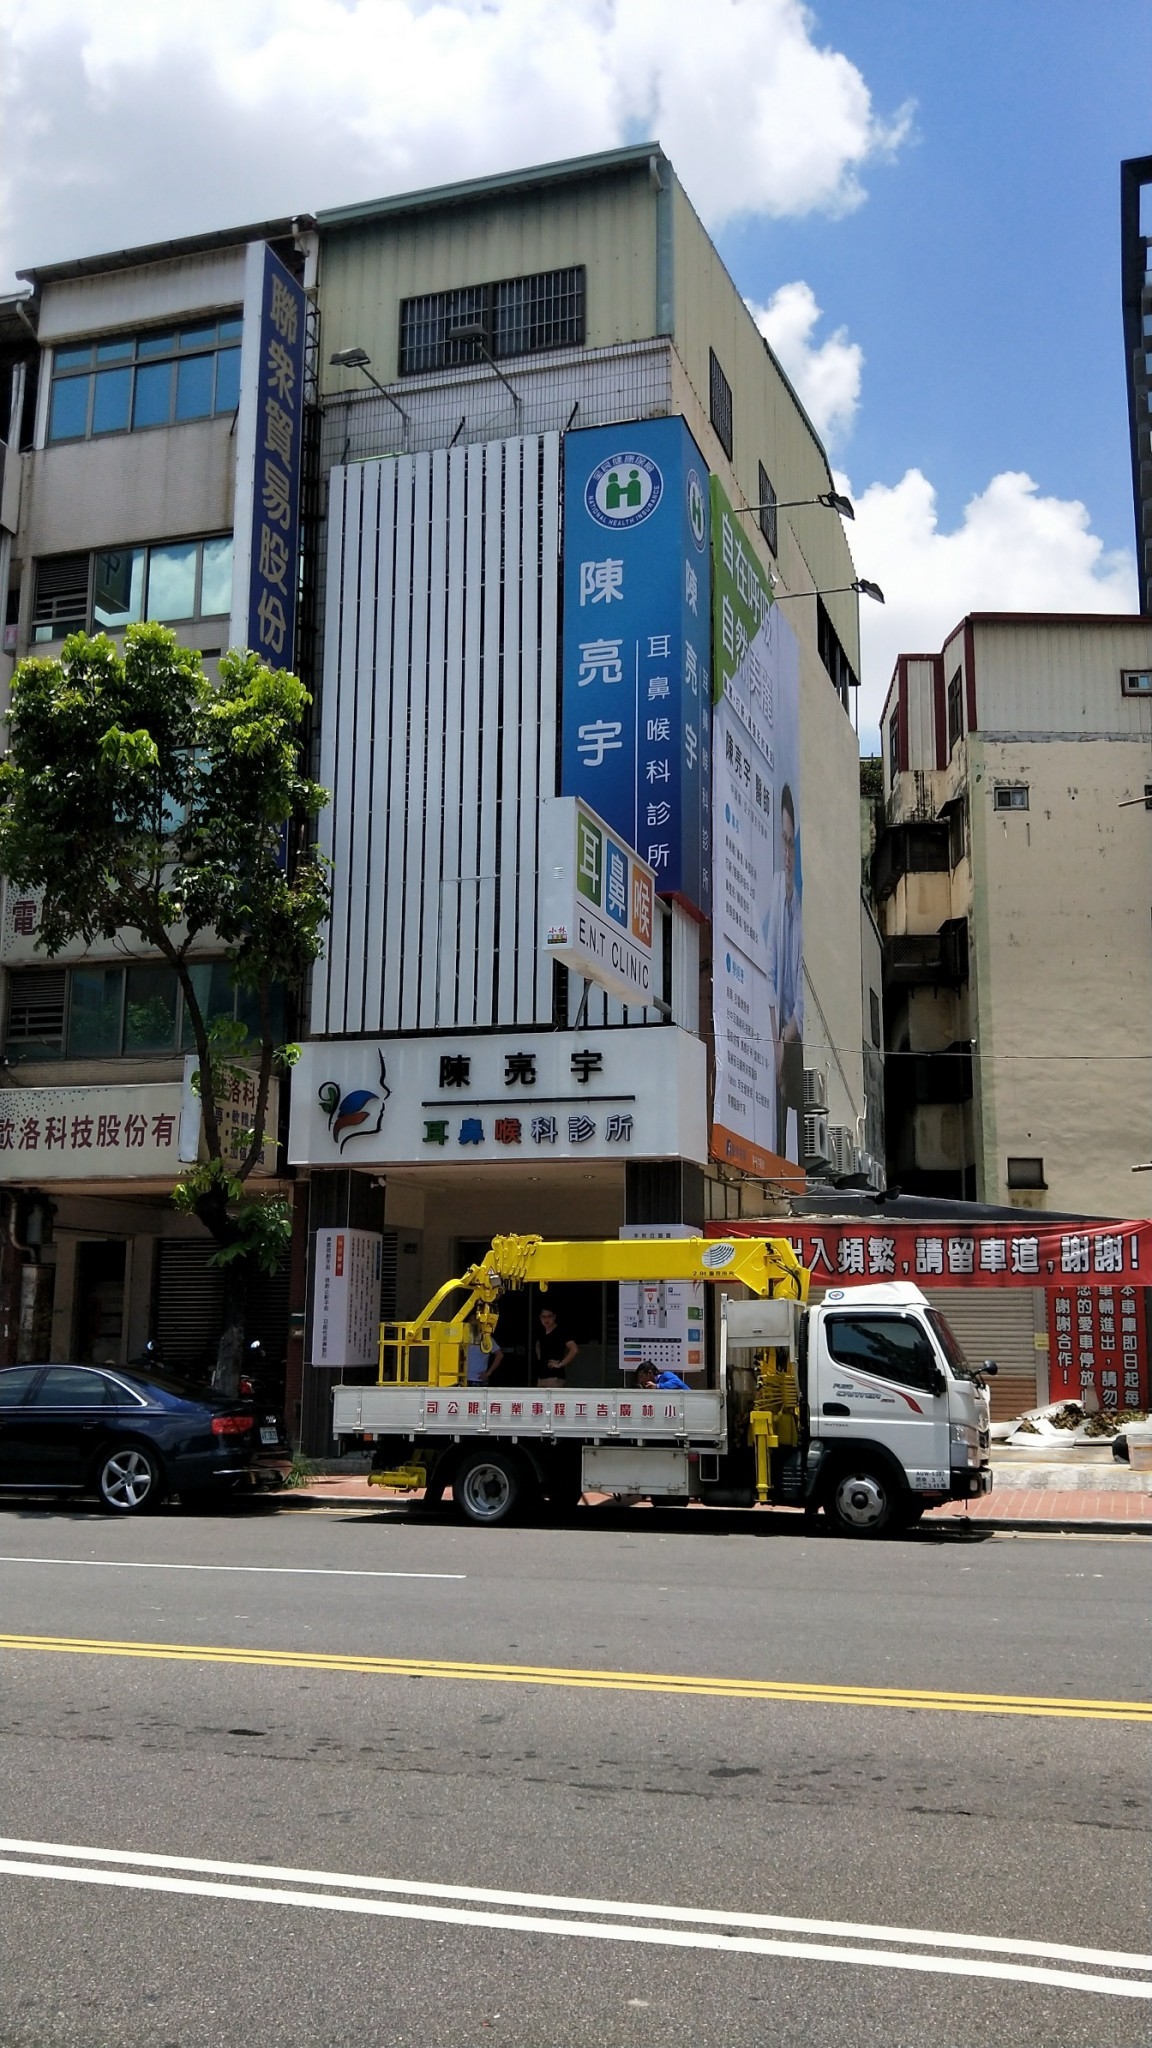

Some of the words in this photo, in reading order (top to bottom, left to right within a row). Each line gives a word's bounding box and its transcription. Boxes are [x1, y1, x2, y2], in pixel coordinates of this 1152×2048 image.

[578, 558, 624, 767] 陳亮宇
[646, 634, 671, 868] 耳鼻喉科診所
[580, 823, 650, 938] 耳鼻喉
[611, 941, 649, 989] CLINIC
[439, 1049, 603, 1088] 陳亮宇
[422, 1114, 635, 1147] 耳鼻喉科診所
[1077, 1286, 1095, 1403] 您的愛車停放
[1099, 1286, 1118, 1411] 車輛進出，請勿
